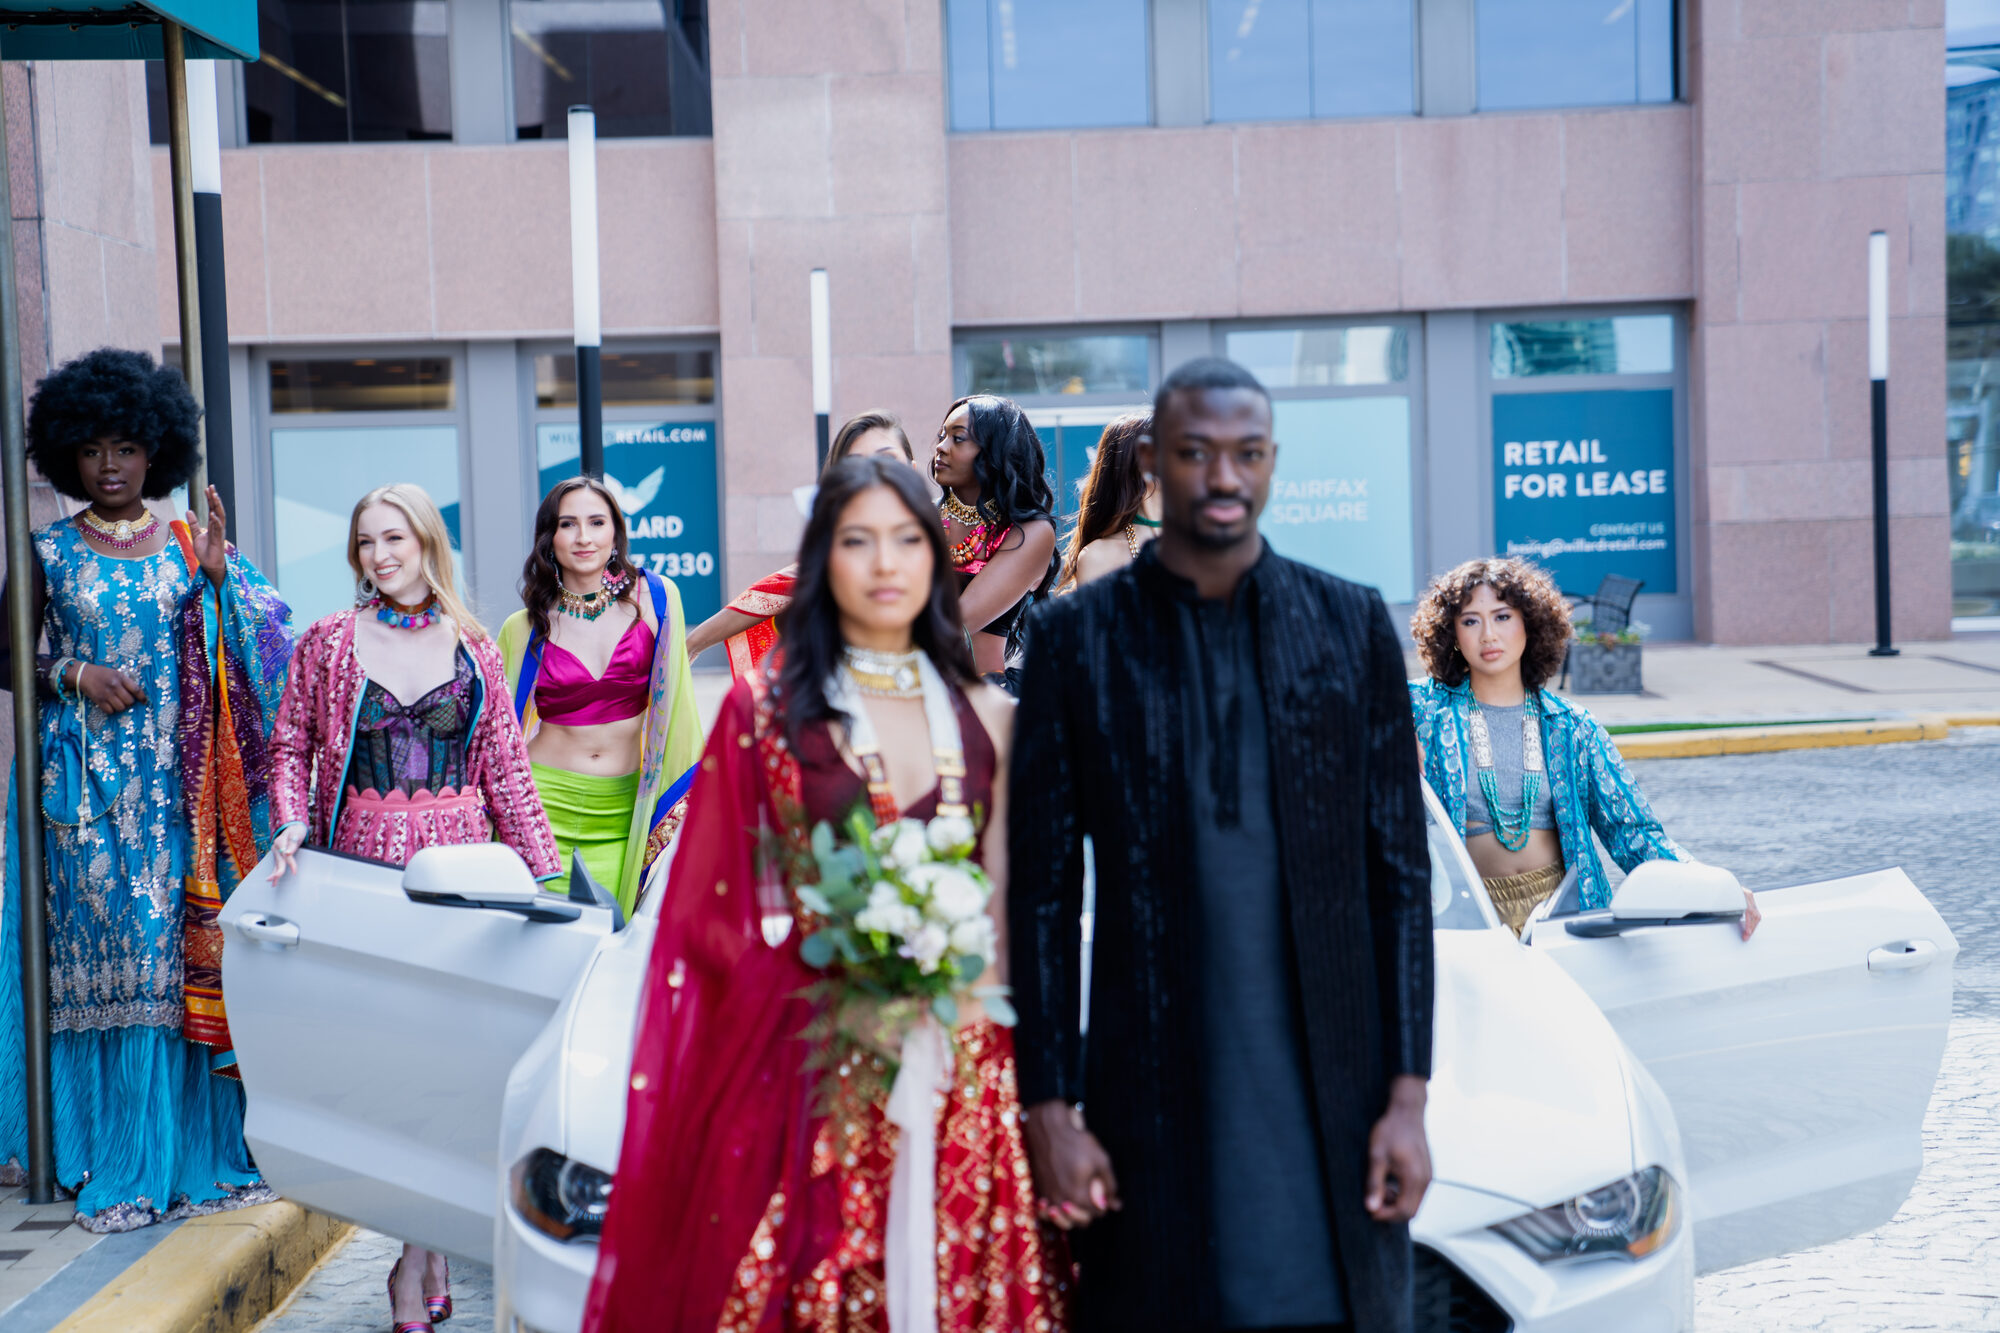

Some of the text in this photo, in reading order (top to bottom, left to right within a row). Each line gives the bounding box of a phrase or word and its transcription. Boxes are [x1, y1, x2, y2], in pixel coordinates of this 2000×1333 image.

[1504, 439, 1607, 466] RETAIL
[1273, 479, 1368, 498] FAIRFAX
[1505, 470, 1666, 499] FOR LEASE
[1272, 502, 1368, 524] SQUARE
[625, 515, 684, 539] LARD
[1590, 522, 1665, 536] CONTACT US
